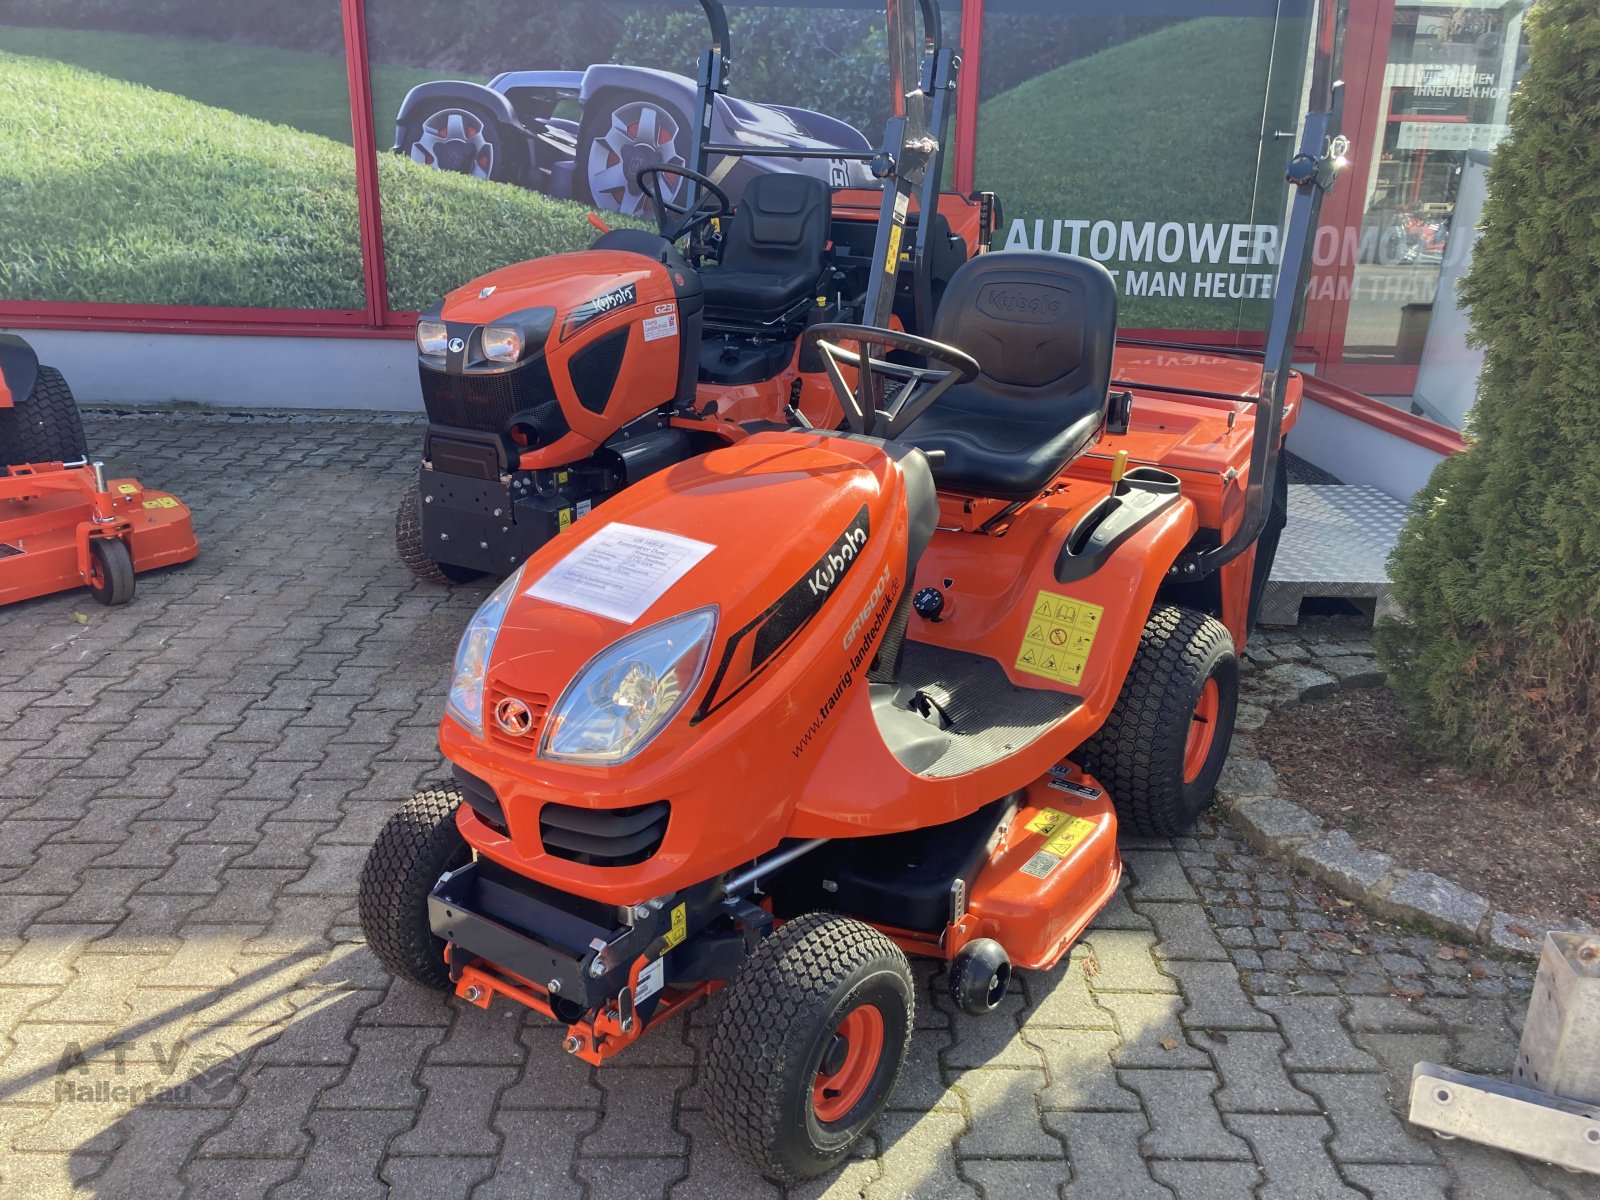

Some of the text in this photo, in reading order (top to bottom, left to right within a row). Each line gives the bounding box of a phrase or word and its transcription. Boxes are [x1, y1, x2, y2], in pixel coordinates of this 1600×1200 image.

[1414, 85, 1451, 97] IHNEN
[1453, 86, 1478, 98] DEN
[1004, 218, 1280, 264] AUTOMOWER
[1125, 272, 1186, 297] MAN
[592, 286, 634, 312] Kubota
[655, 304, 675, 314] G231
[988, 290, 1061, 315] Kubota
[808, 526, 867, 596] Kubota
[792, 577, 900, 759] www.traurig-landtechnik.de
